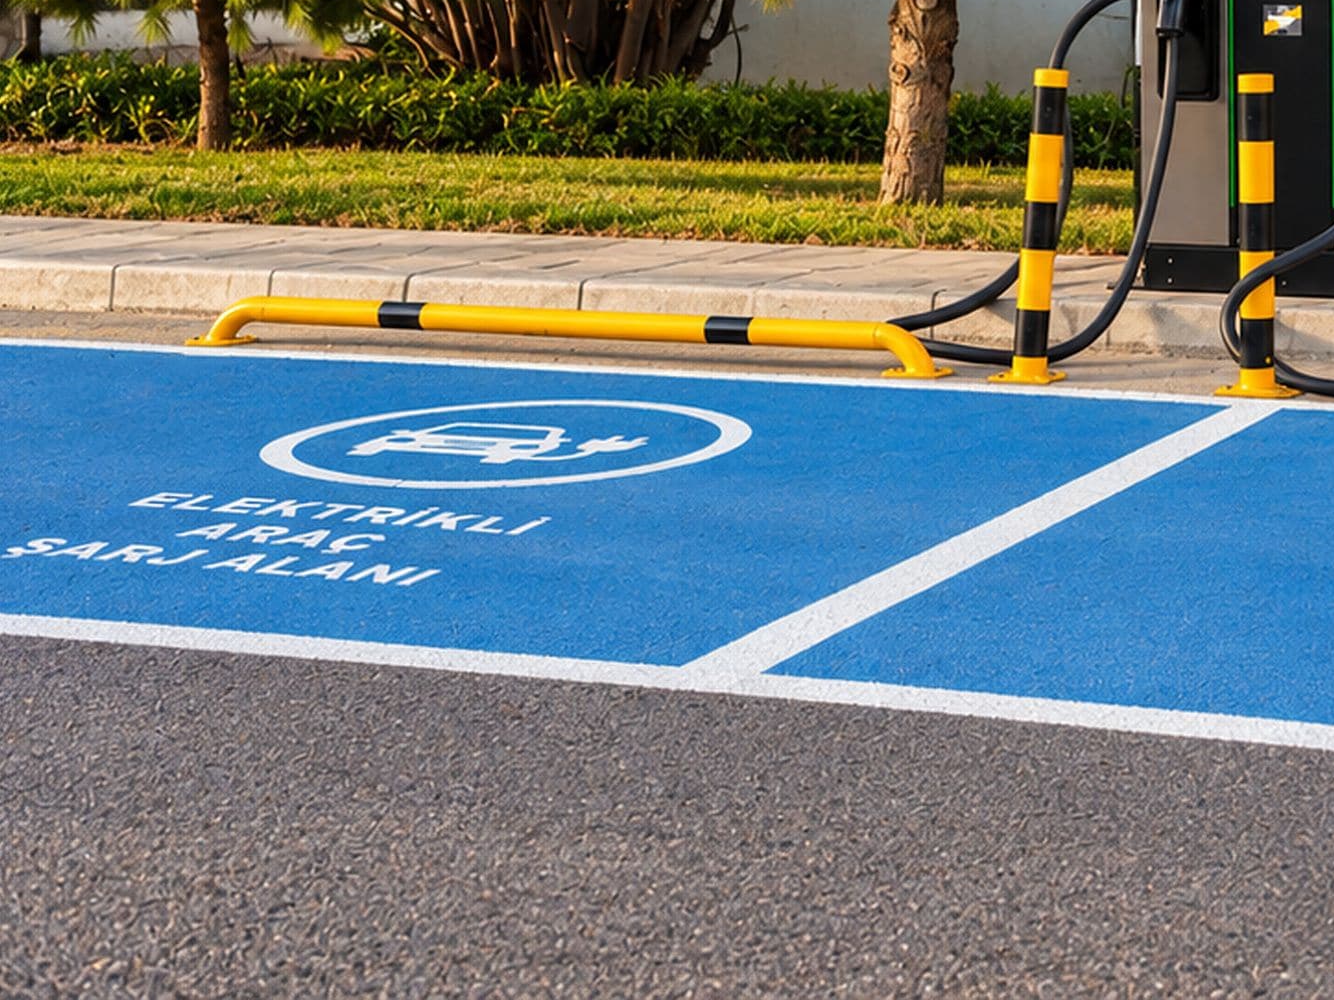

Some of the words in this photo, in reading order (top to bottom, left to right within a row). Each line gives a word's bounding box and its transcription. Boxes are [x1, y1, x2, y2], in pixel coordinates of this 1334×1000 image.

[129, 492, 551, 535] ELEKTRİKLİ
[176, 522, 386, 554] ARAÇ
[2, 537, 209, 563] ŞARJ
[202, 553, 441, 586] ALANI
